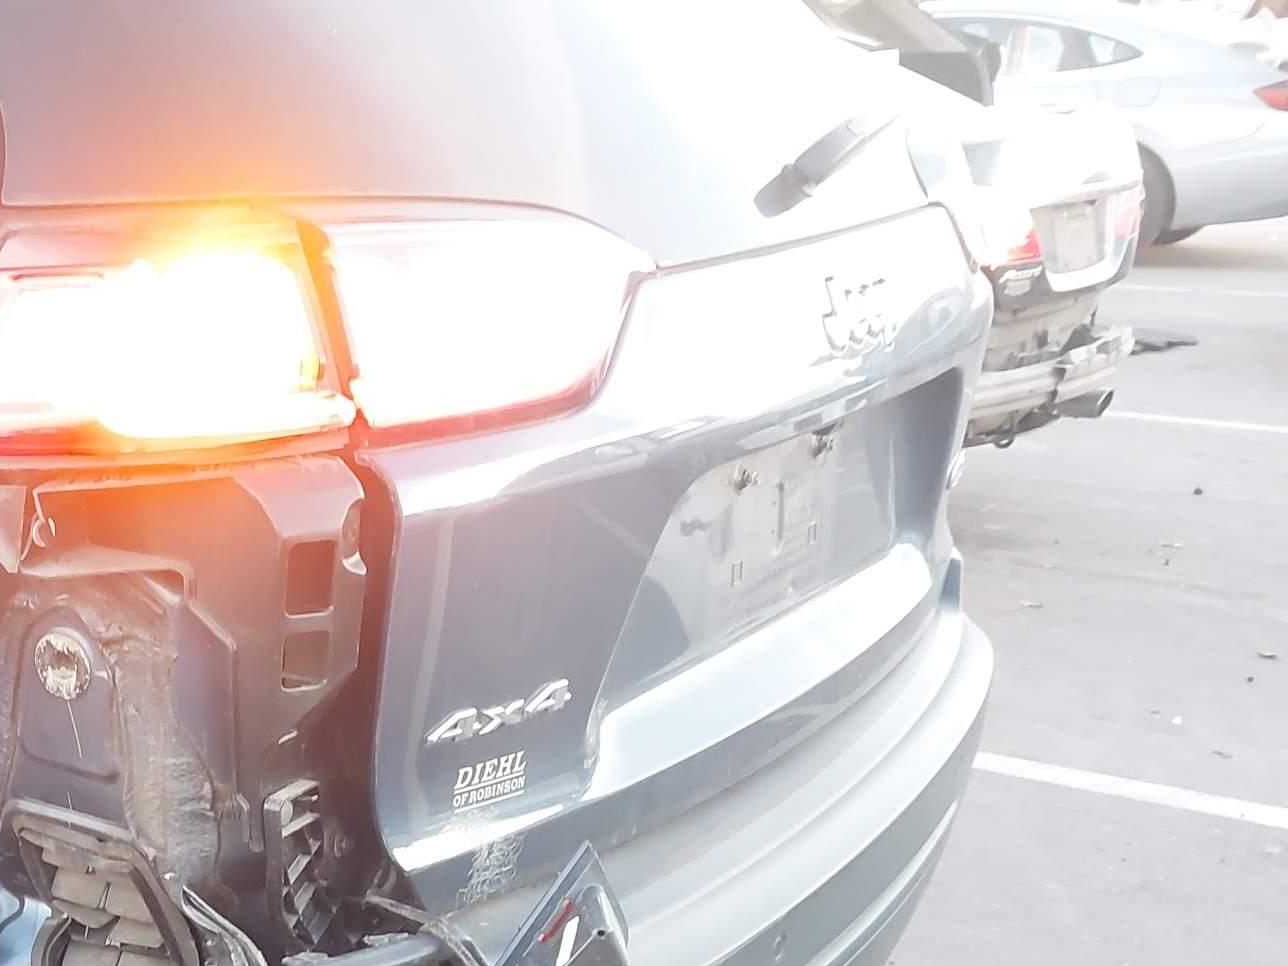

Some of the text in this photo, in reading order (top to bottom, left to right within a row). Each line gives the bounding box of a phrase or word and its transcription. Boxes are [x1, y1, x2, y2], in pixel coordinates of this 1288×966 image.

[454, 751, 526, 787] DIEHL
[452, 776, 525, 807] OF ROBINSON
